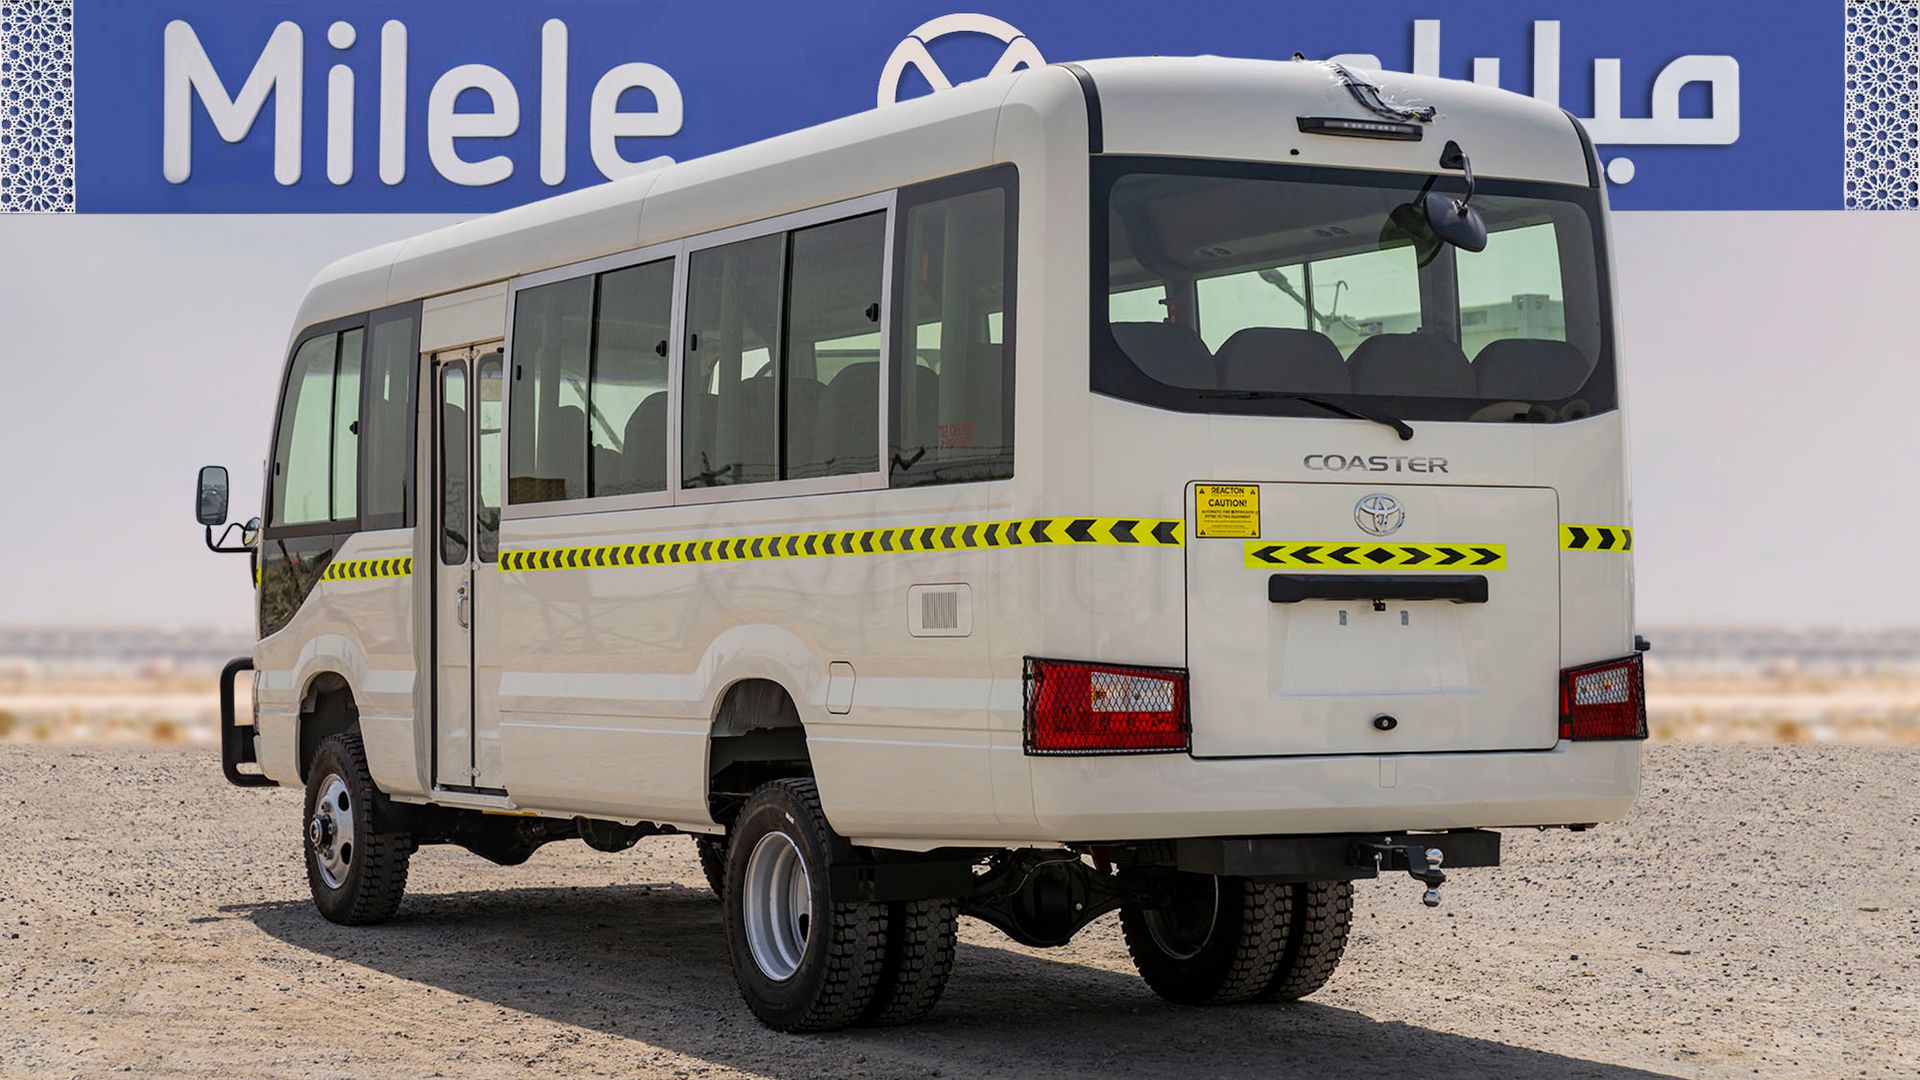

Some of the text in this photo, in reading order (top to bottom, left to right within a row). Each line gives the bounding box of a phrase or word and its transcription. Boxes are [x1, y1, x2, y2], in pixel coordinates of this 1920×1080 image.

[163, 18, 684, 187] Milele
[1303, 454, 1449, 473] COASTER
[1211, 486, 1245, 494] REACTON
[1208, 498, 1248, 507] CAUTION!
